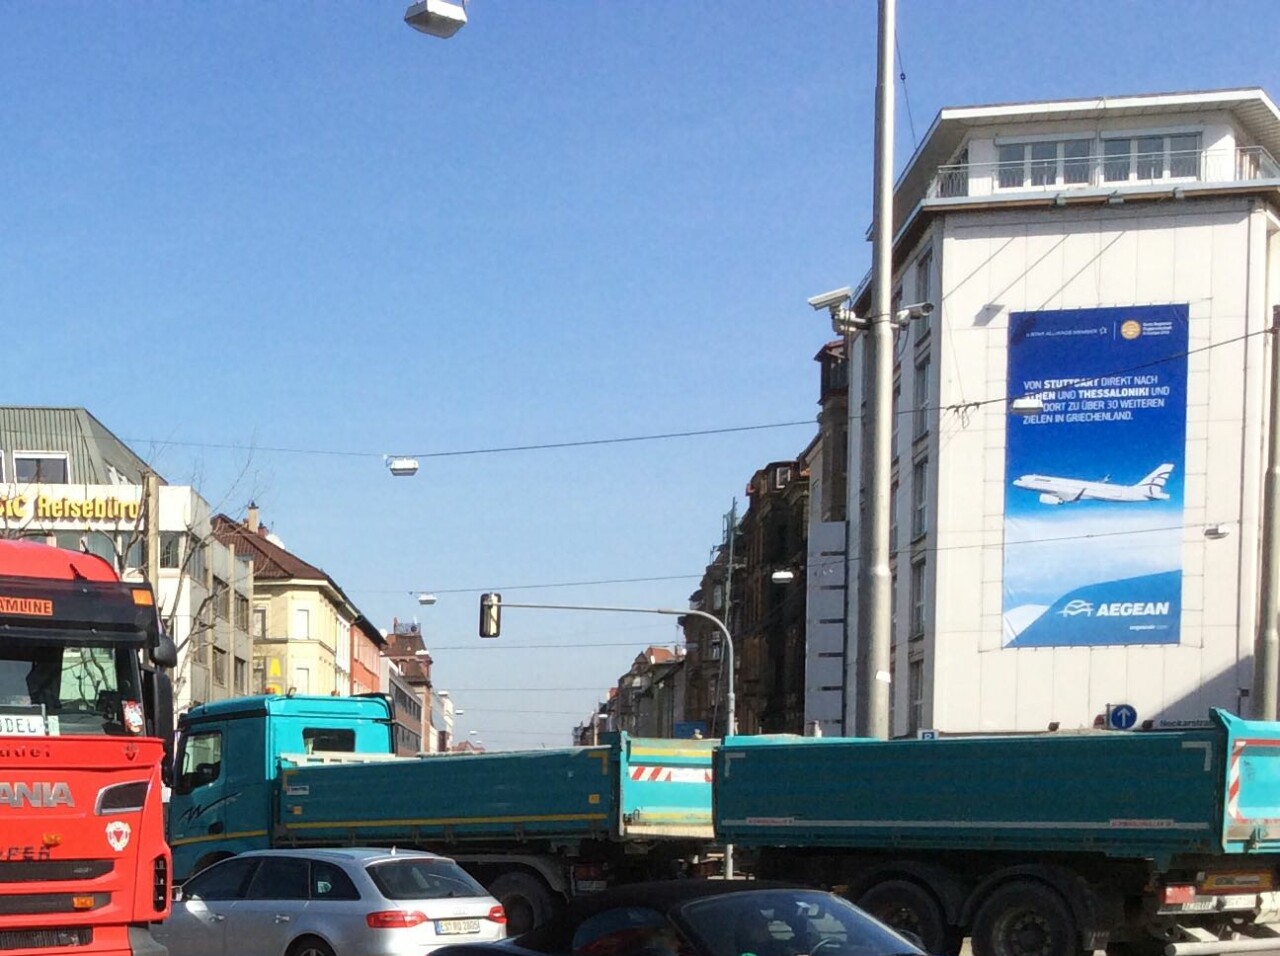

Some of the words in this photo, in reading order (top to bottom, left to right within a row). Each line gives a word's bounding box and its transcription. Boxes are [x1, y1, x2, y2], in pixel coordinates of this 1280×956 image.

[1023, 380, 1042, 390] VON
[1043, 378, 1099, 389] STUTTGART
[1100, 376, 1132, 387] DIREKT
[1133, 375, 1158, 385] NACH
[1057, 390, 1076, 400] UND
[1078, 387, 1149, 399] THESSALONIKI
[1151, 386, 1170, 396] UND
[1043, 402, 1066, 412] DORT
[1067, 401, 1080, 411] ZU
[1081, 399, 1105, 410] ÜBER
[1106, 399, 1119, 409] 30
[1120, 397, 1165, 408] WEITEREN
[1023, 414, 1054, 424] ZIELEN
[1055, 413, 1064, 423] IN
[1065, 411, 1133, 422] GRIECHENLAND.
[37, 495, 140, 520] Reisebüro
[1096, 602, 1170, 616] AEGEAN
